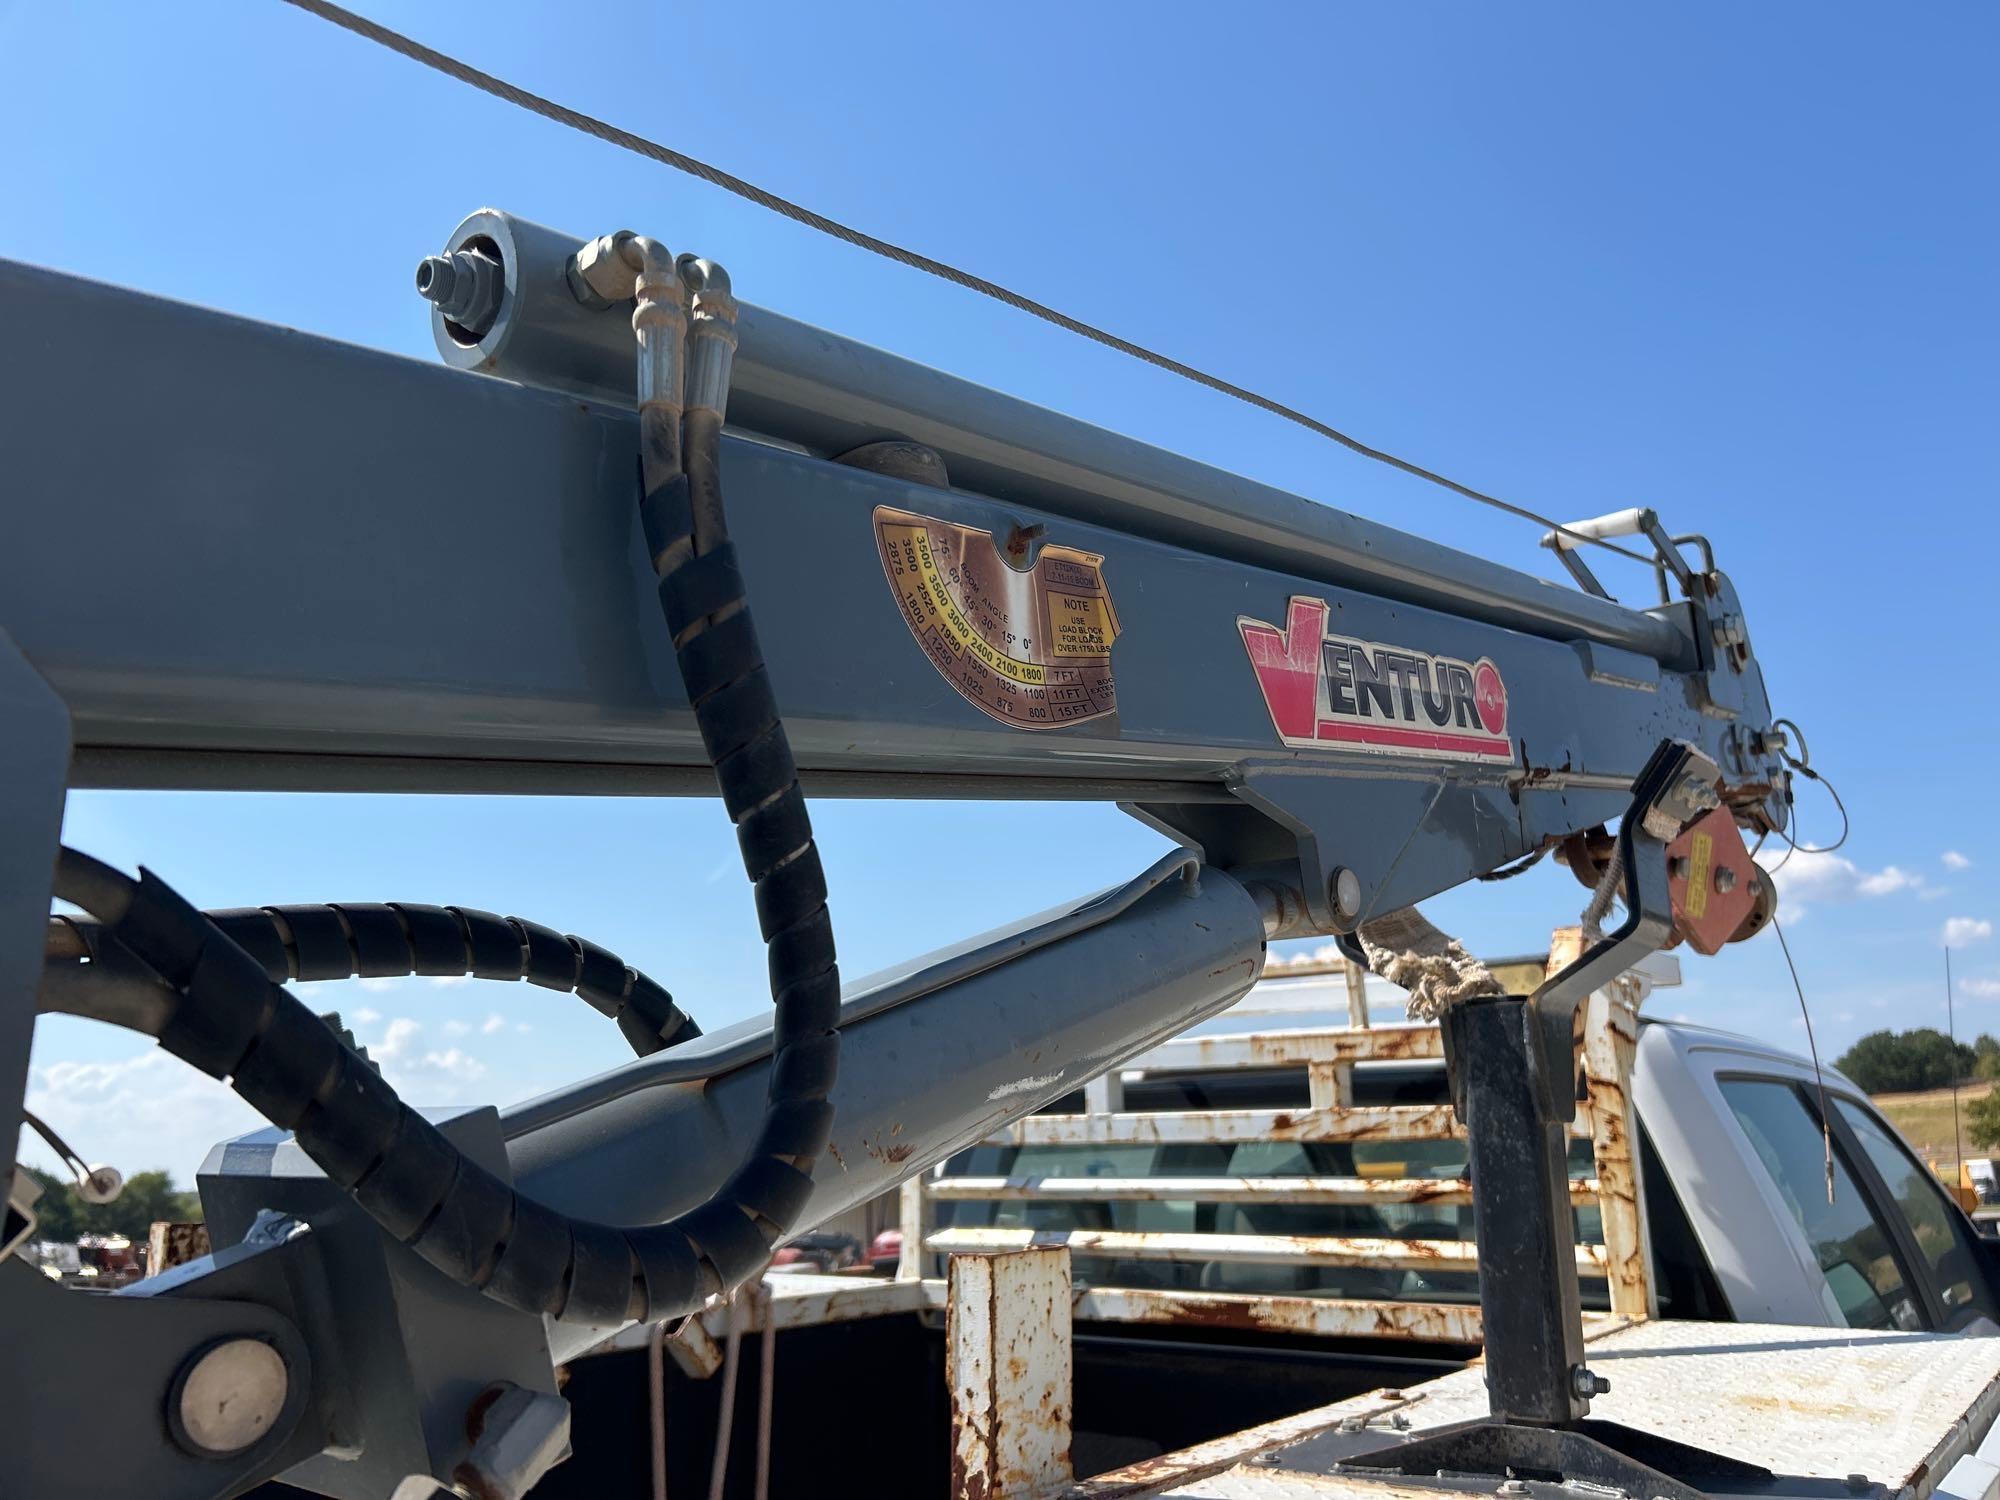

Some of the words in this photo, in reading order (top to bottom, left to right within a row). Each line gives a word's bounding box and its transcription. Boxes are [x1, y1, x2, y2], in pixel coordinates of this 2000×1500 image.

[916, 536, 932, 569] 3500
[929, 574, 948, 606] 3500
[947, 608, 969, 638] 3000
[970, 637, 993, 662] 2400
[996, 658, 1018, 676] 2100
[1021, 668, 1042, 680] 1800
[960, 562, 980, 594] BOOM
[981, 598, 1009, 624] ANGLE
[1063, 598, 1090, 612] NOTE
[888, 541, 904, 576] 2875
[905, 592, 925, 624] 1800
[931, 637, 952, 665] 1250
[962, 672, 984, 696] 1025
[997, 696, 1013, 712] 875
[1029, 707, 1046, 718] 800
[902, 538, 918, 572] 3500
[916, 582, 937, 616] 2525
[940, 623, 961, 652] 1950
[967, 655, 988, 679] 1550
[995, 677, 1017, 695] 1325
[1024, 688, 1045, 700] 1100
[981, 615, 997, 631] 30°
[1001, 630, 1016, 644] 15°
[1022, 638, 1032, 650] 0°
[1058, 624, 1077, 634] LOAD
[1078, 626, 1104, 635] BLOCK
[1071, 617, 1086, 625] USE
[1058, 644, 1078, 653] OVER
[1079, 644, 1095, 653] 1750
[1062, 634, 1078, 643] FOR
[1079, 635, 1104, 644] LOADS
[1241, 599, 1506, 738] VENTURO
